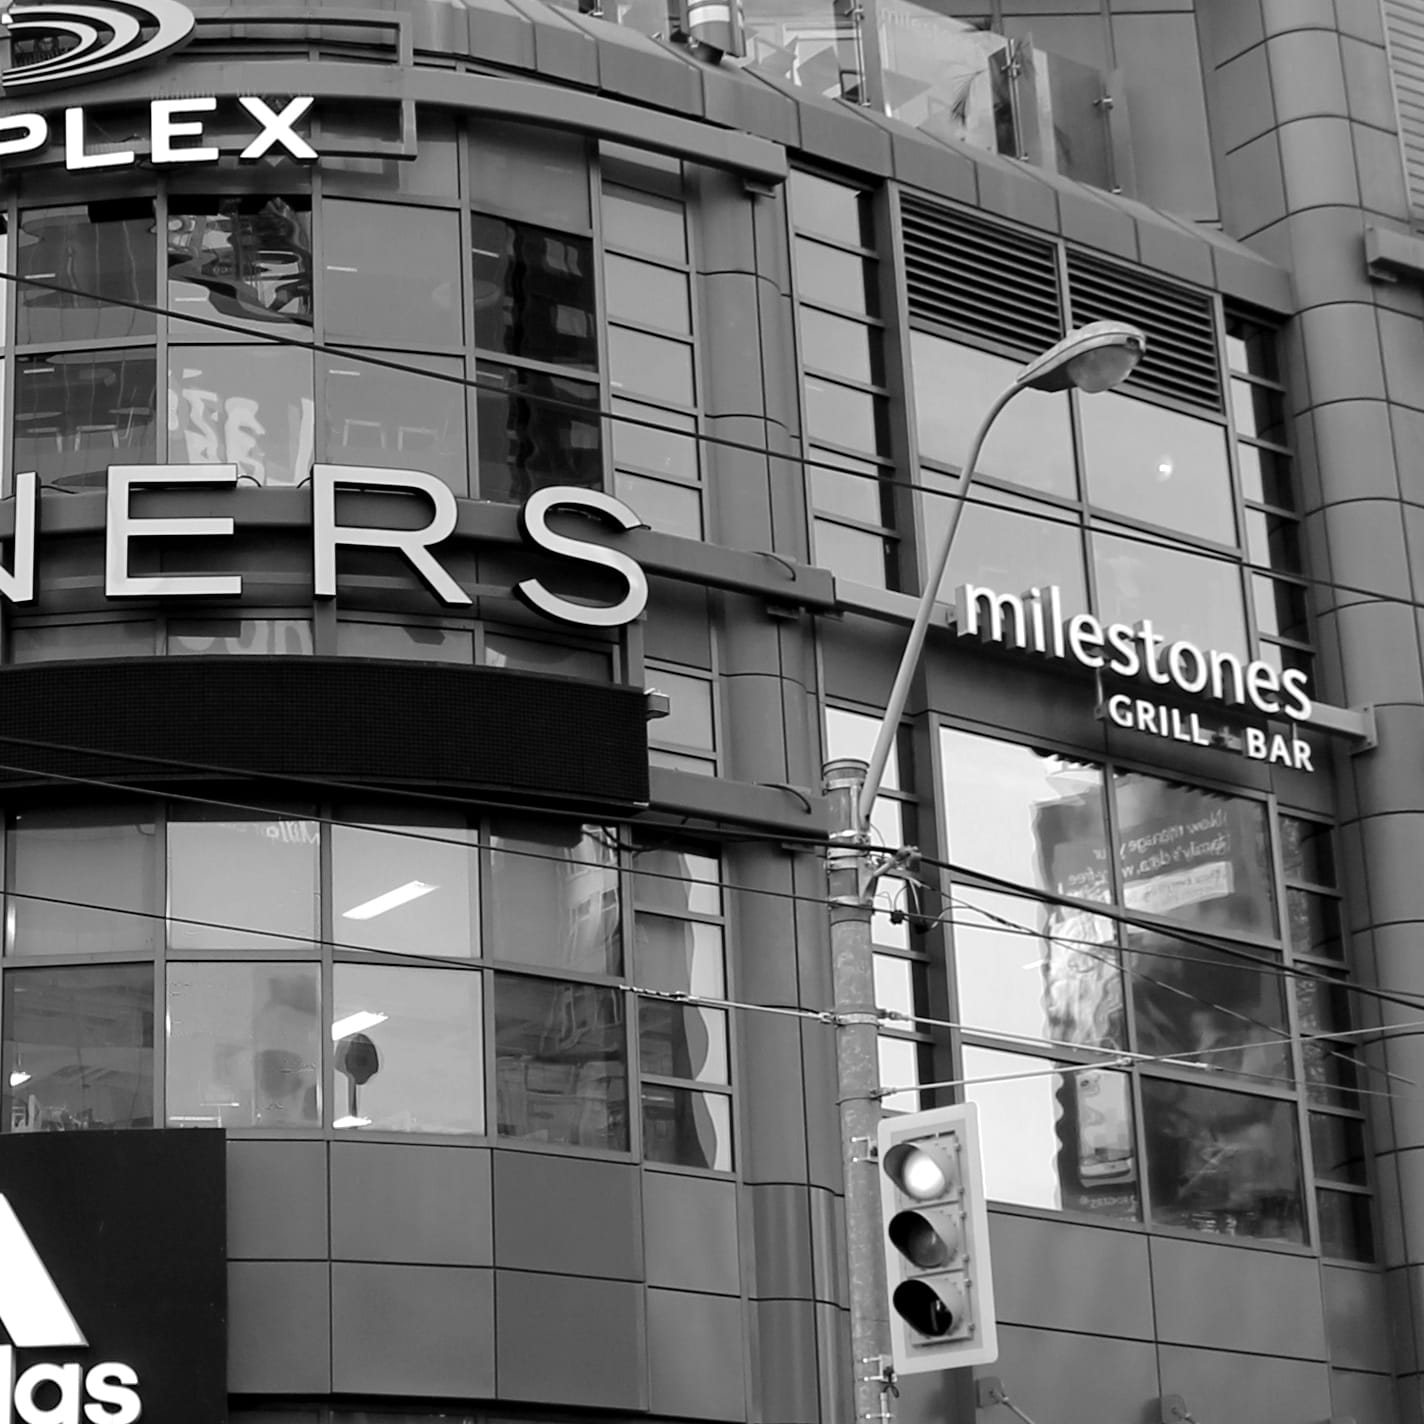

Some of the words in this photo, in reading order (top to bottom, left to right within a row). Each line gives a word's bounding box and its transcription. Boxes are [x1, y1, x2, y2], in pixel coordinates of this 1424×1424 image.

[958, 582, 1314, 722] milestones
[1107, 692, 1211, 748] GRILL
[1244, 725, 1315, 773] BAR
